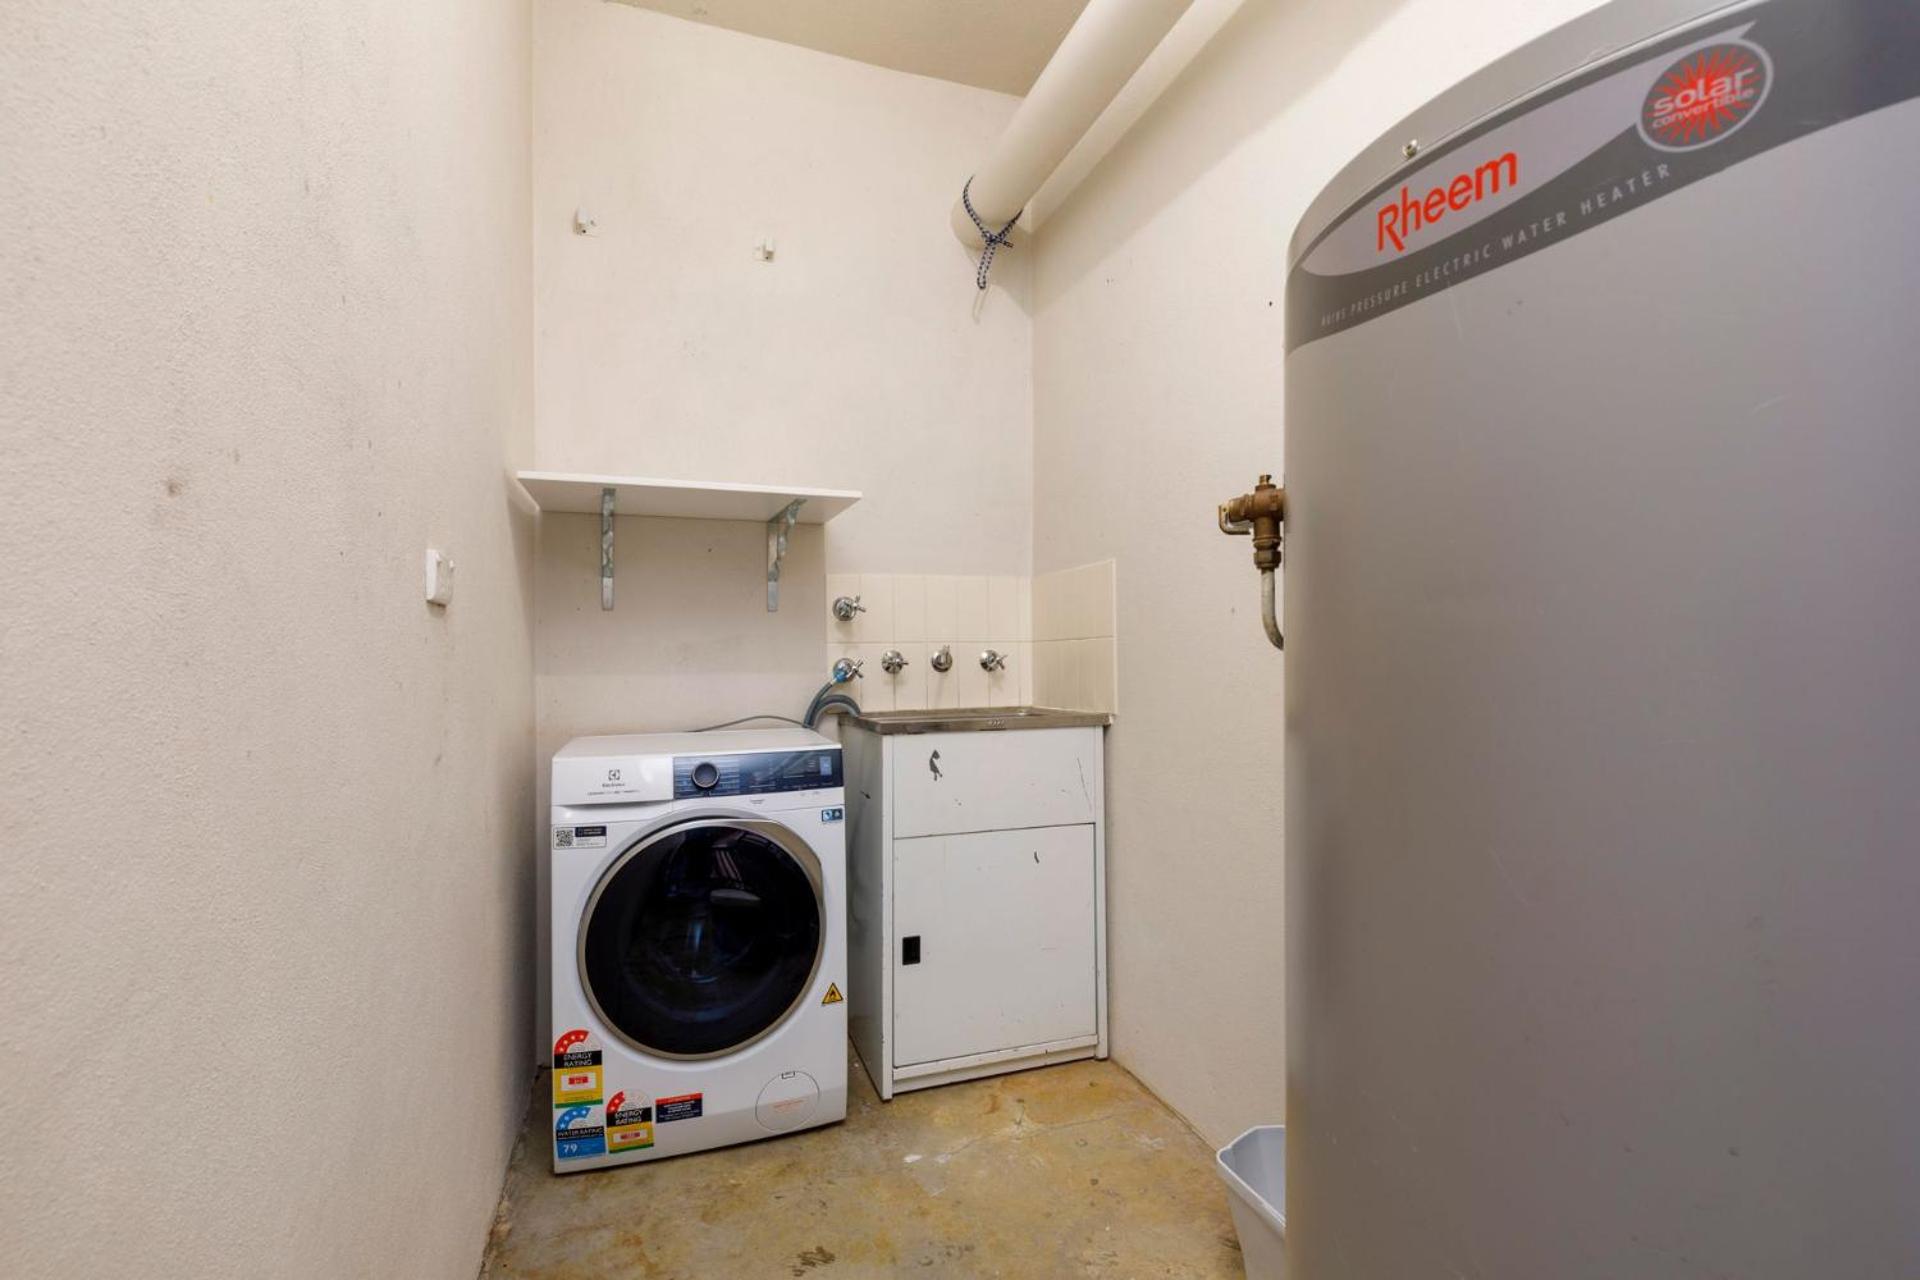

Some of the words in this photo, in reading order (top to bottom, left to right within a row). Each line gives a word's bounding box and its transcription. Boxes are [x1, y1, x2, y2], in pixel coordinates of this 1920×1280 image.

[1652, 88, 1755, 128] convertible
[1653, 67, 1755, 117] solar
[1376, 151, 1518, 252] Rheem
[1351, 281, 1408, 317] PRESSURE
[1416, 244, 1491, 288] ELECTRIC
[1501, 212, 1567, 250] WATER
[1580, 163, 1670, 215] HEATER
[563, 1052, 592, 1061] ENERGY
[563, 1143, 578, 1153] 79
